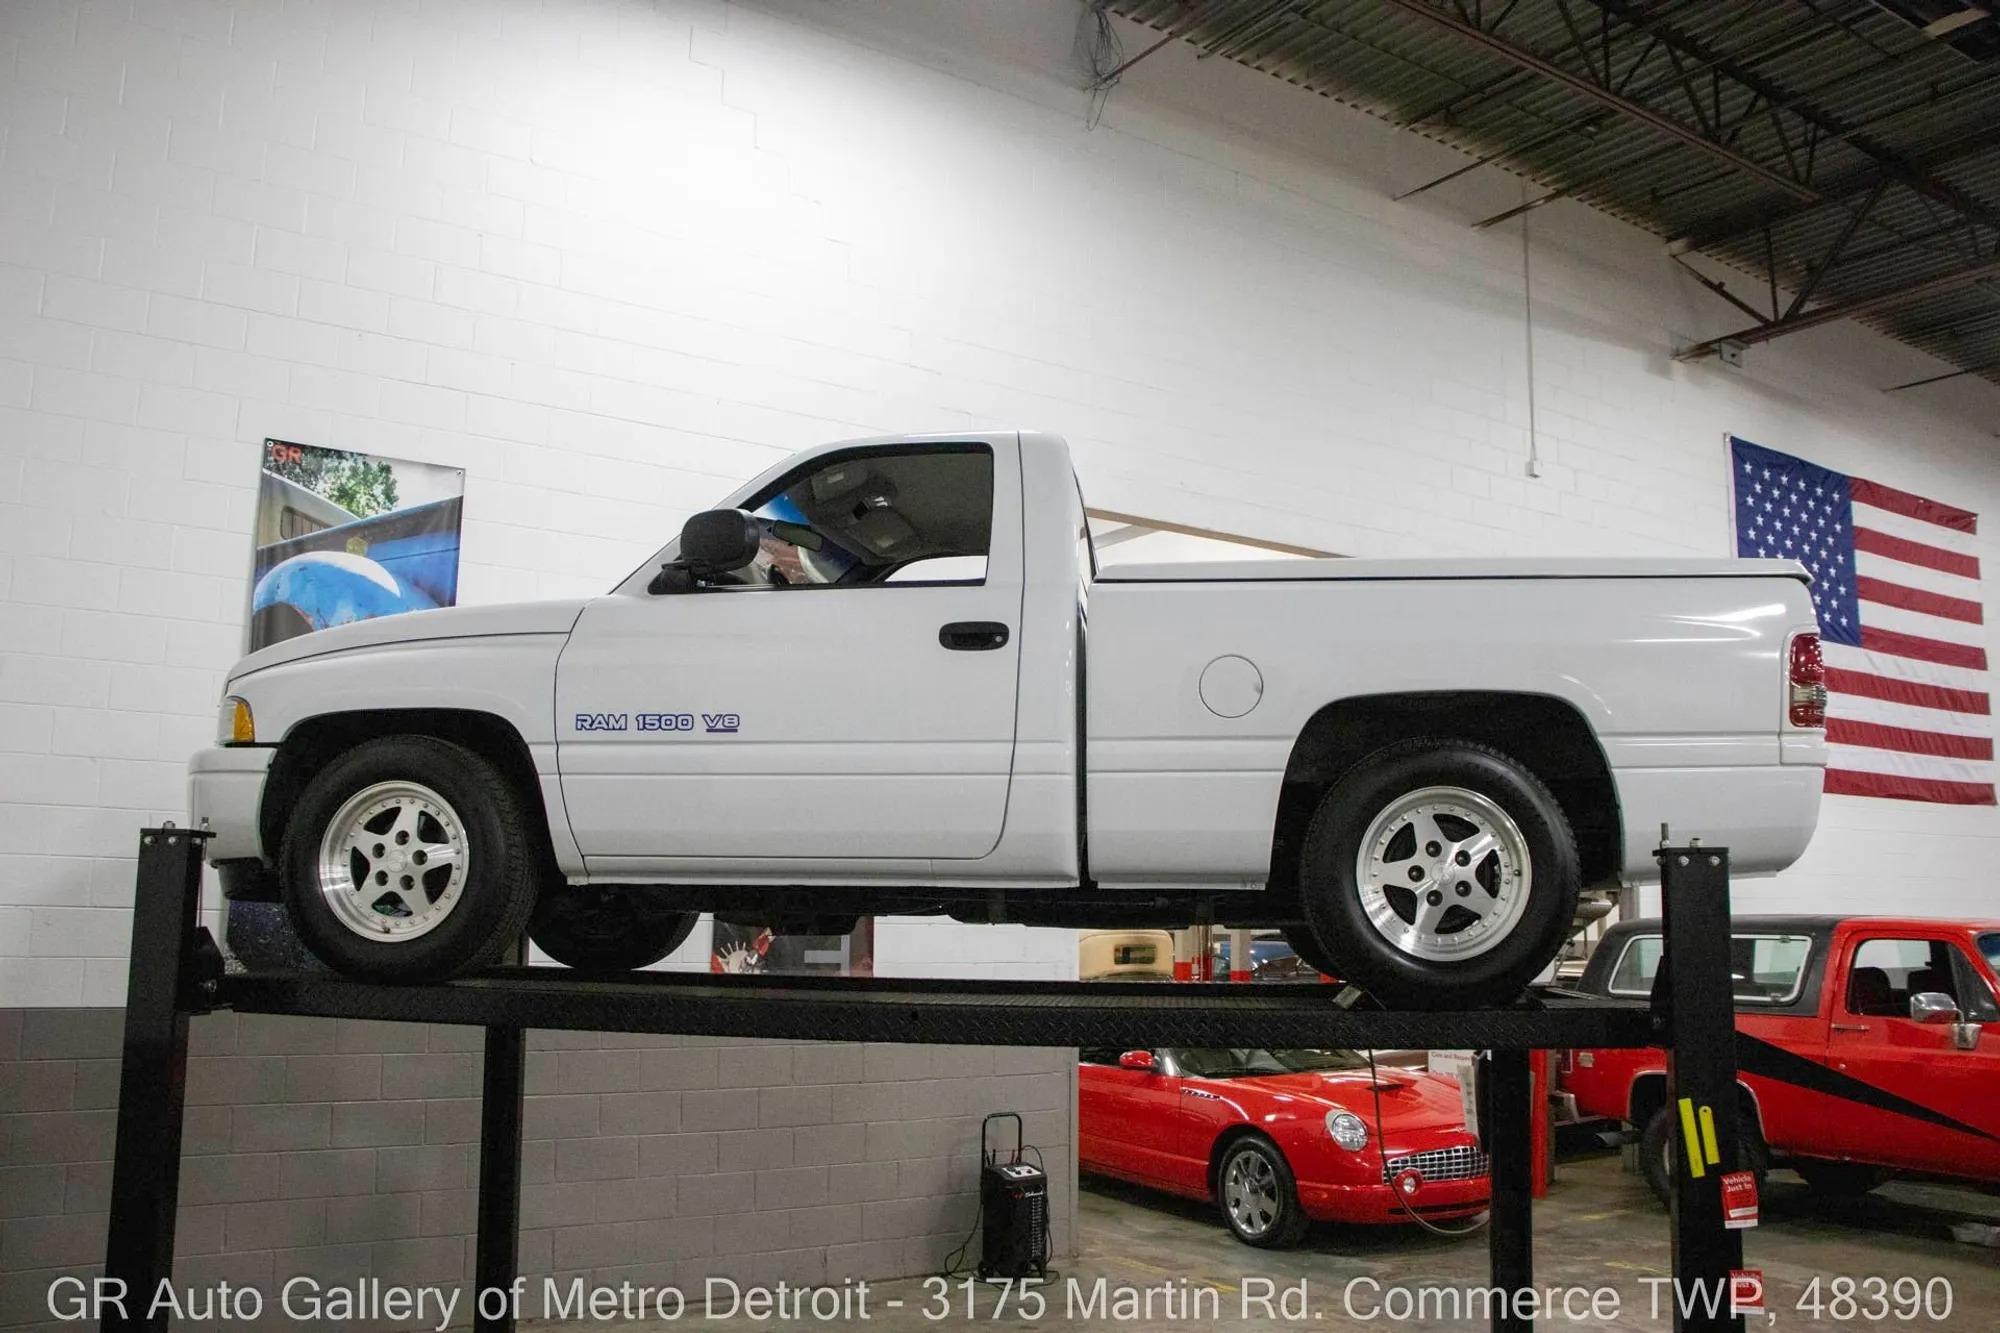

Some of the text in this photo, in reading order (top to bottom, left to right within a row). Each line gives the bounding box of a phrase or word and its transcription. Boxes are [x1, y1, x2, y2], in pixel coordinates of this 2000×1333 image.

[271, 444, 302, 465] GR
[576, 714, 740, 731] RAM 1500 V8
[1722, 1175, 1752, 1185] Vehicle
[1727, 1184, 1744, 1193] Just
